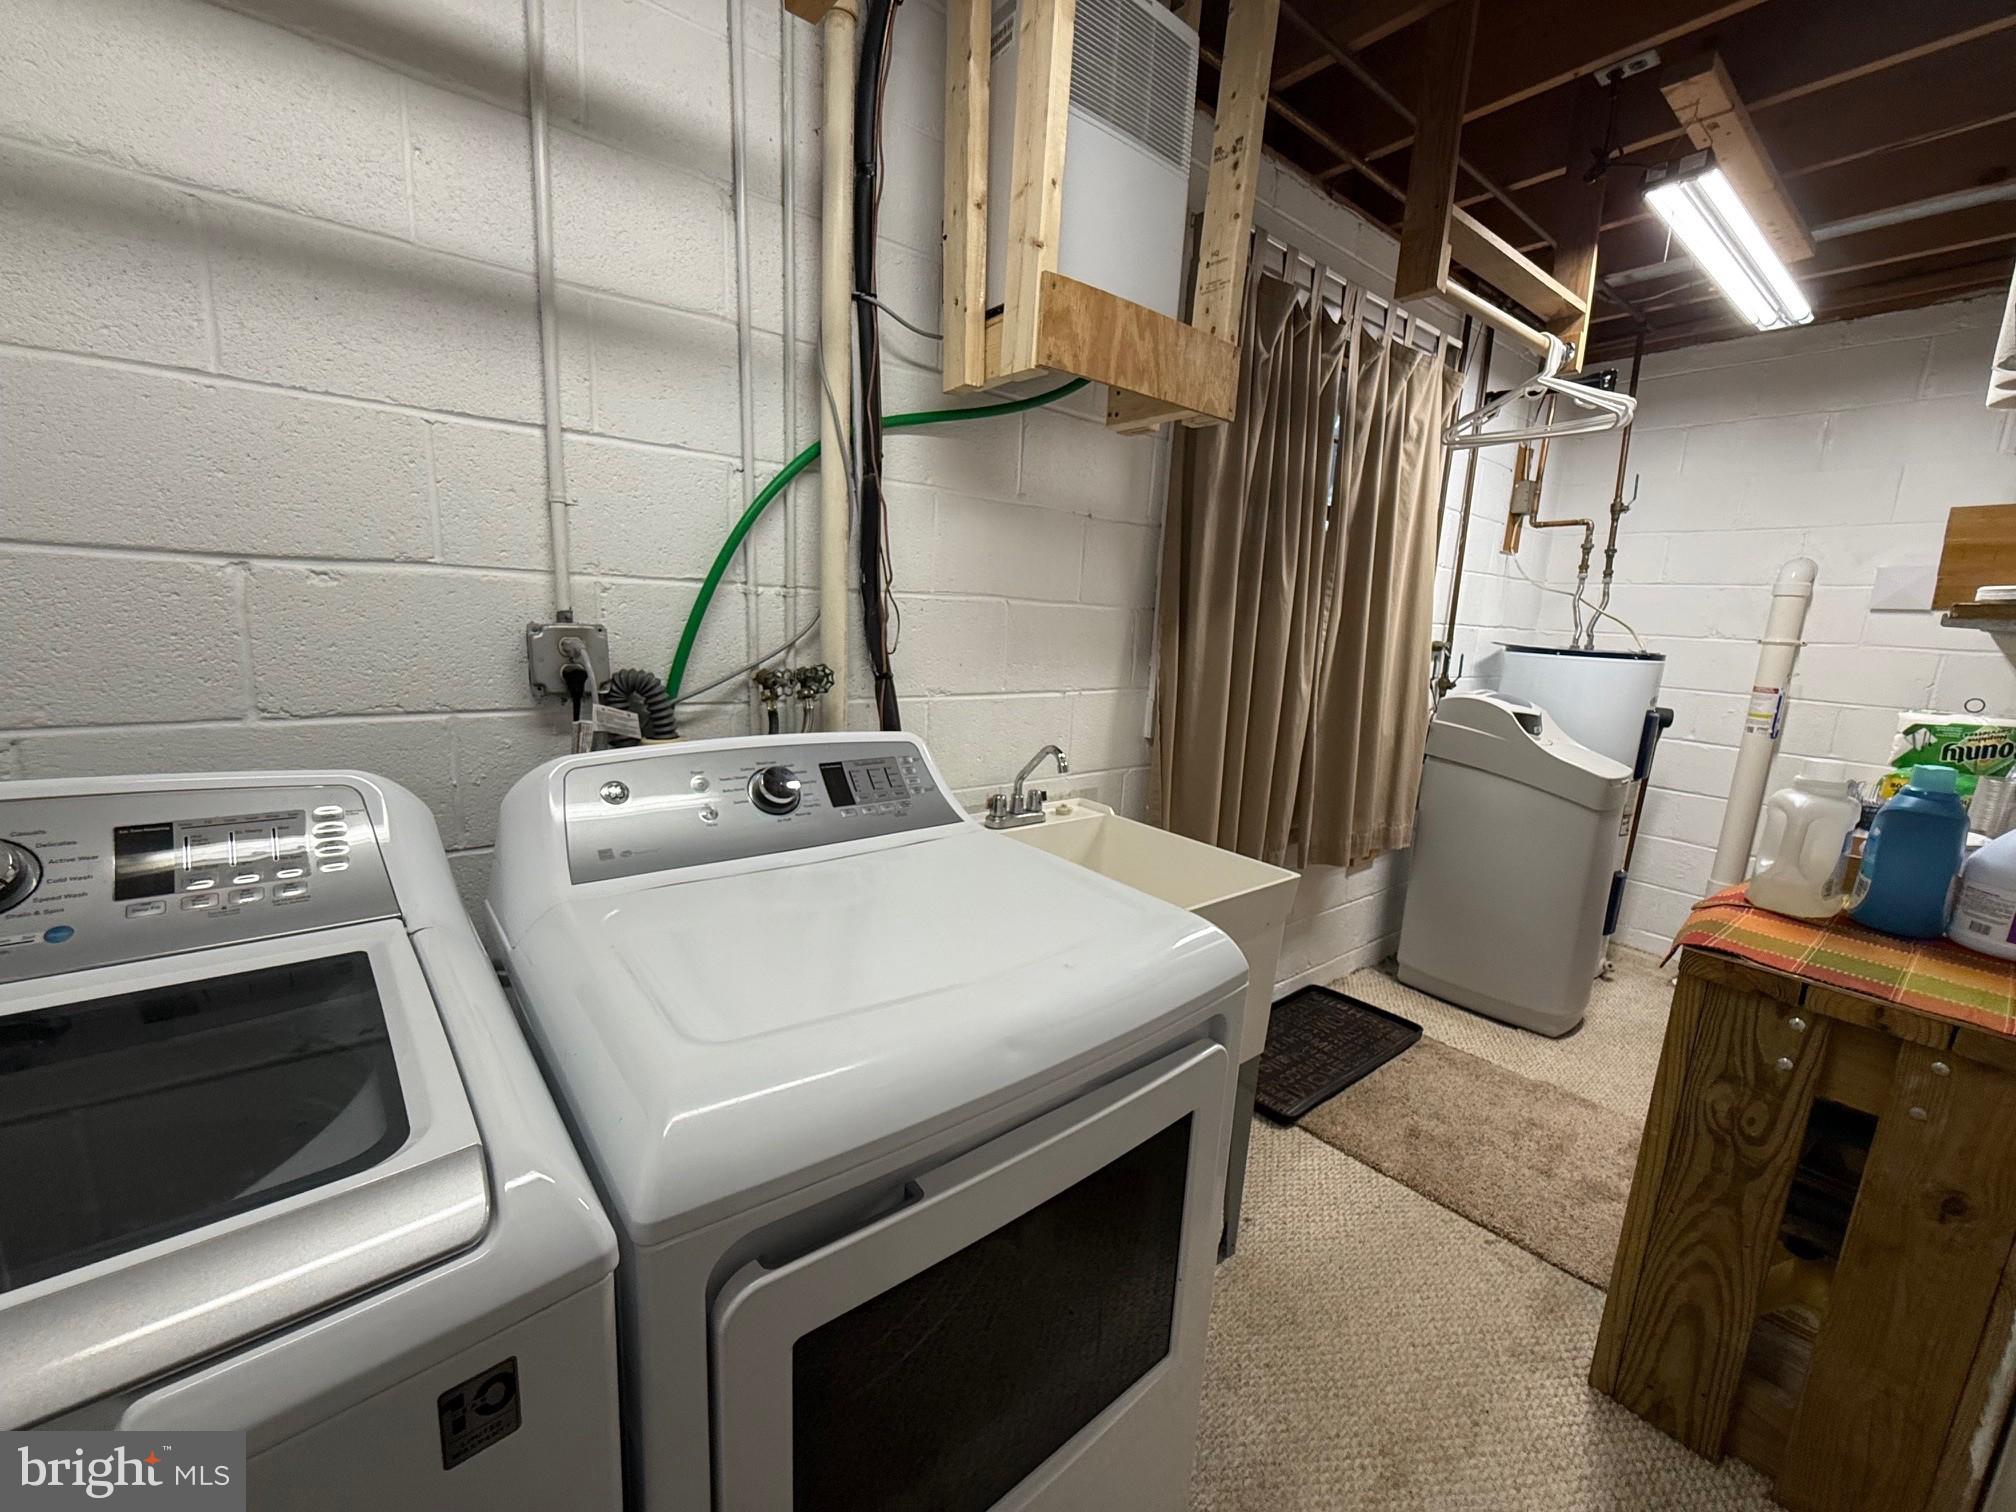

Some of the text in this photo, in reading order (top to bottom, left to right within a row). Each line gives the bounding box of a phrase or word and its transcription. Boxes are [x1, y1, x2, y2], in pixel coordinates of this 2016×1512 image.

[1968, 735, 2008, 743] Napkins
[1941, 742, 2016, 763] ounty
[35, 840, 78, 849] Delicates
[48, 857, 76, 865] Active
[46, 874, 94, 885] Cold Wash
[33, 891, 89, 904] Speed Wash
